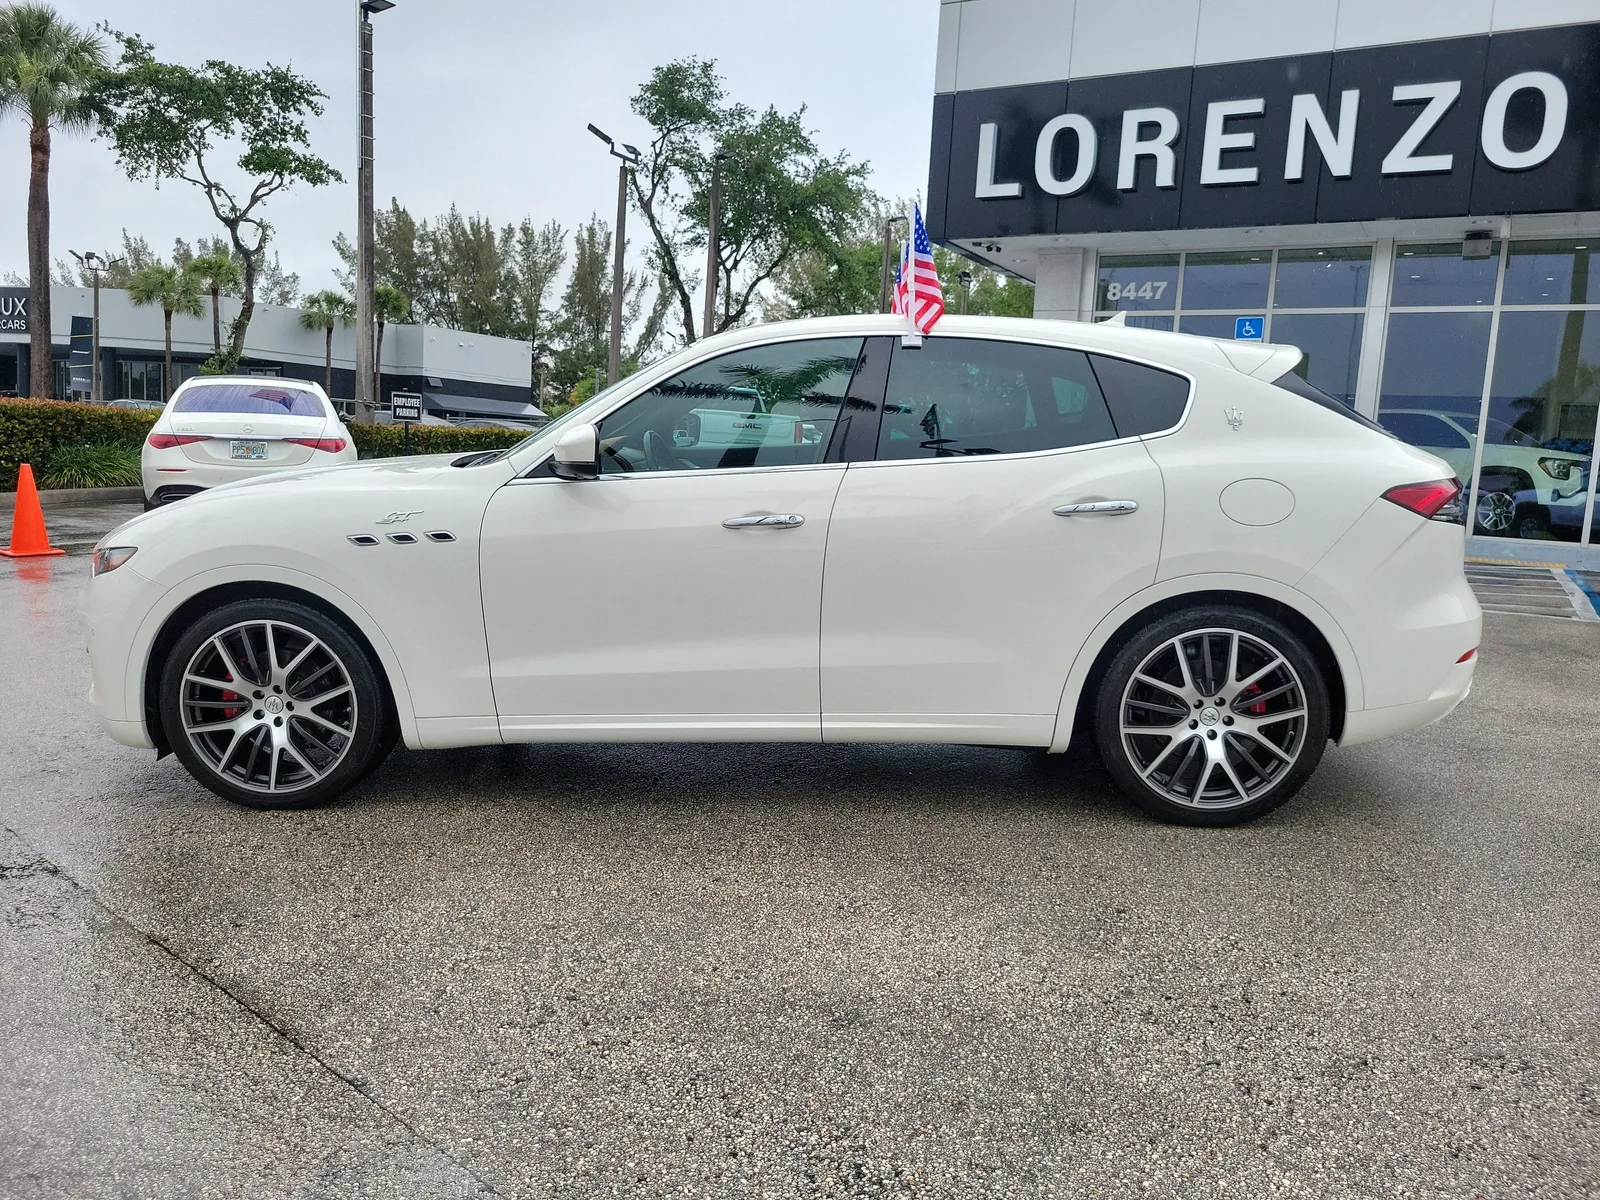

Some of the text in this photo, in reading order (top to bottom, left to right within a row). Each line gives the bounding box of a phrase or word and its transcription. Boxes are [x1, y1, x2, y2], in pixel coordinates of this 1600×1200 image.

[975, 71, 1568, 199] LORENZO
[1106, 281, 1168, 301] 8447
[1, 297, 27, 316] UX
[0, 319, 26, 330] CARS
[394, 397, 420, 407] EMPLOYEE
[396, 407, 418, 417] PARKING
[732, 422, 762, 430] GMC
